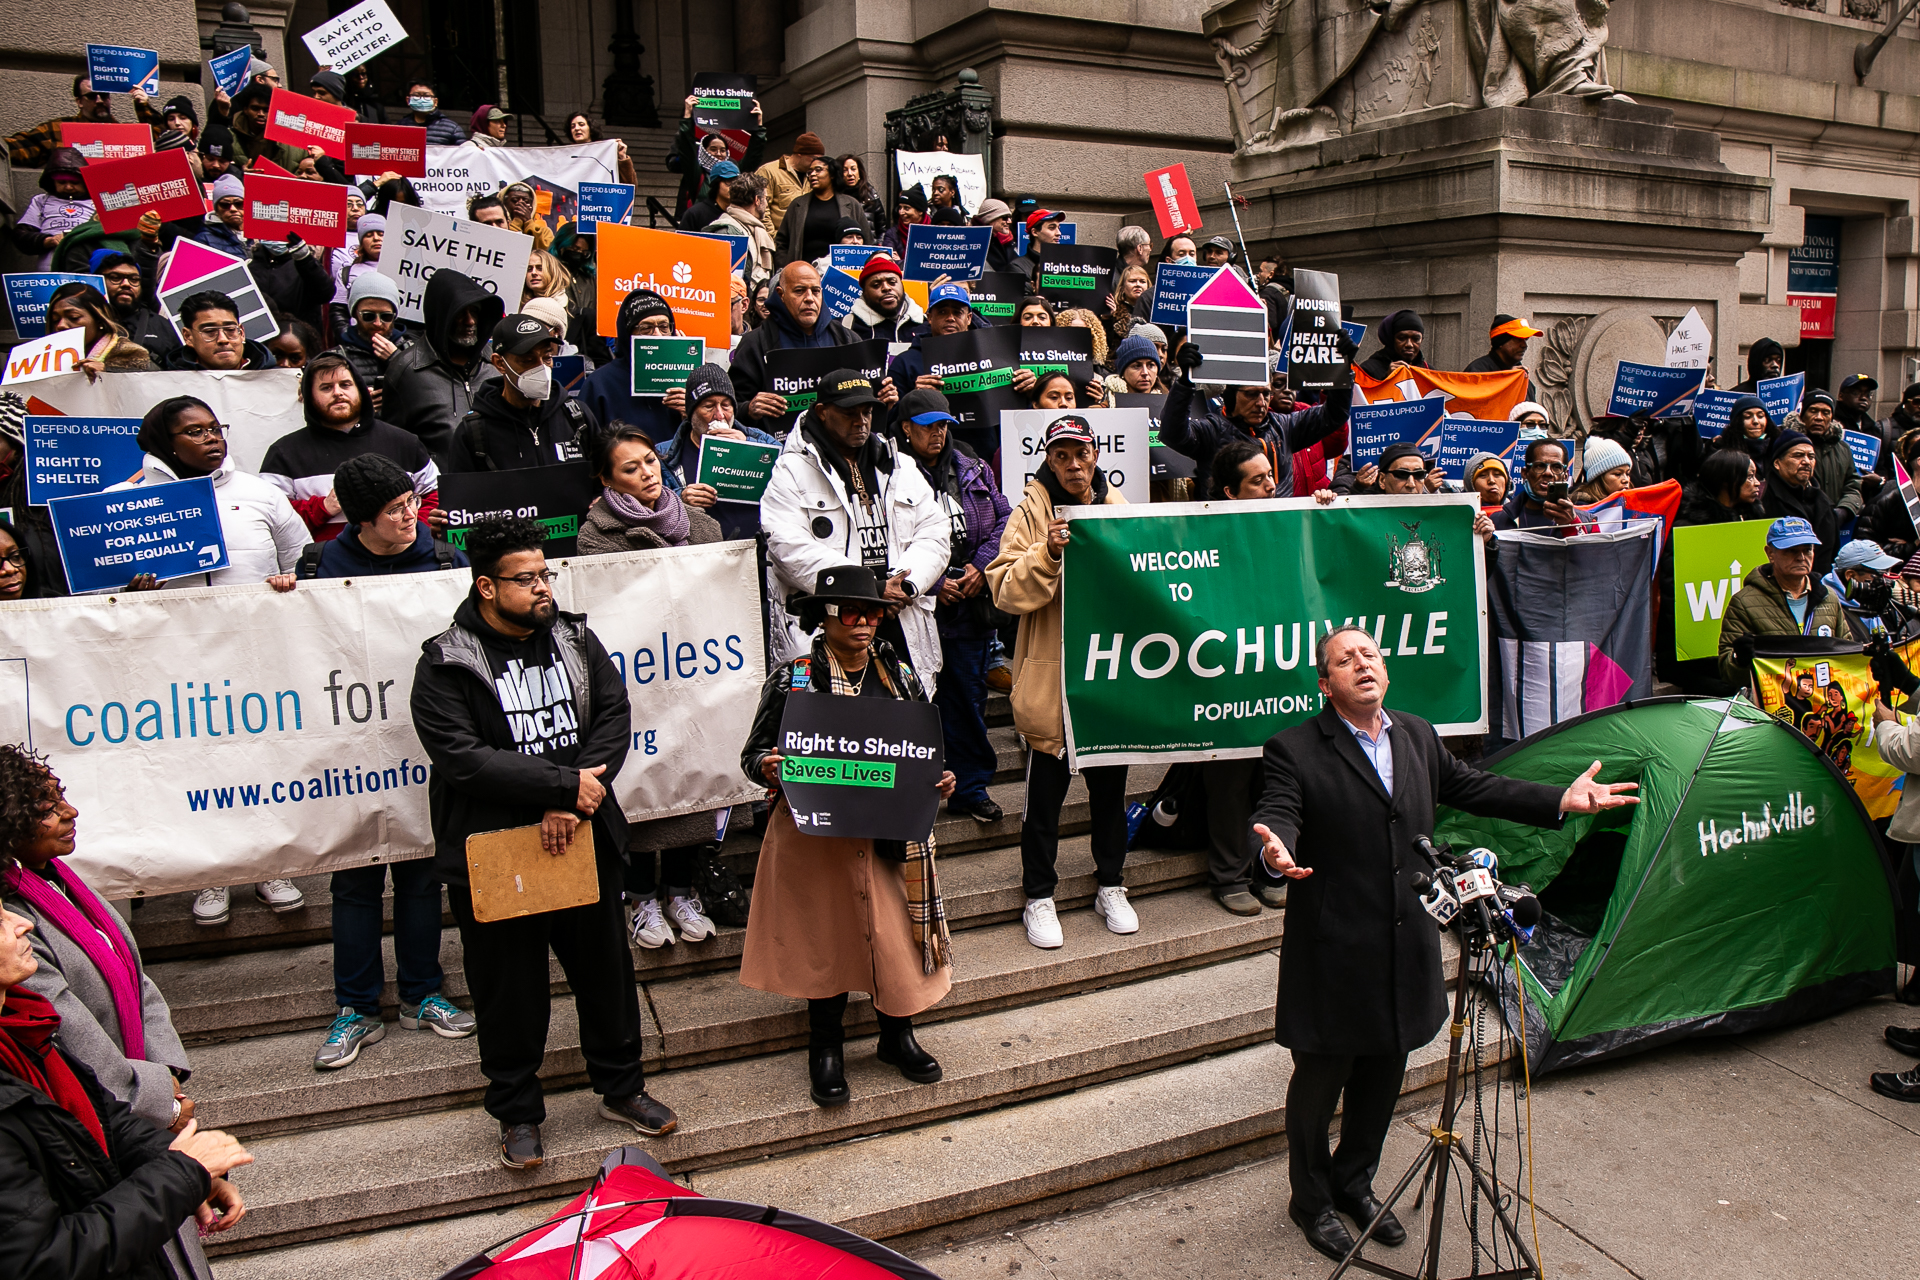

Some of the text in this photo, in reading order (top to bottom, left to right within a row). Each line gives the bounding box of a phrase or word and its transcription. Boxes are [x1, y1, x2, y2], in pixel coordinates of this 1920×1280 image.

[319, 9, 376, 46] SAVE THE
[327, 22, 383, 57] RIGHT TO
[91, 48, 117, 57] DEFEND
[335, 33, 391, 70] SHELTER!
[93, 65, 117, 73] RIGHT
[94, 74, 129, 82] SHELTER
[694, 88, 754, 98] Right to Shelter
[719, 99, 740, 108] Lives
[305, 119, 346, 137] HENRY STREET
[304, 126, 346, 144] SETTLEMENT
[104, 144, 124, 152] HENRY
[381, 146, 419, 156] HENRY STREET
[381, 153, 419, 162] SETTLEMENT
[447, 169, 470, 178] FOR
[138, 178, 187, 197] HENRY STREET
[466, 182, 491, 192] AND
[581, 186, 605, 194] DEFEND
[140, 186, 191, 205] SETTLEMENT
[581, 194, 592, 202] THE
[290, 206, 339, 220] HENRY STREET
[581, 204, 613, 215] RIGHT TO
[290, 215, 339, 228] SETTLEMENT
[581, 215, 612, 223] SHELTER
[932, 243, 952, 251] YORK
[952, 243, 982, 251] SHELTER
[1804, 235, 1834, 247] TIONAL
[402, 229, 506, 269] SAVE THE
[1791, 246, 1834, 260] ARCHIVES
[929, 252, 945, 260] FOR
[398, 259, 437, 282] RIG
[920, 261, 971, 270] NEED EQUALLY
[1044, 261, 1110, 275] Right to Shelter
[1162, 269, 1191, 279] DEFEND
[11, 279, 49, 289] DEFEND
[1043, 276, 1095, 287] Saves Lives
[1161, 279, 1176, 287] THE
[614, 272, 717, 304] safehorizon
[824, 284, 842, 298] NEW
[14, 290, 33, 299] THE
[1159, 291, 1188, 301] RIGHT
[17, 302, 50, 313] RIGHT
[835, 300, 850, 313] FOR
[983, 304, 1014, 314] Adams!
[1296, 298, 1340, 313] HOUSING
[1792, 299, 1822, 309] MUSEUM
[1314, 316, 1325, 327] IS
[1801, 321, 1820, 331] DIAN
[1290, 346, 1345, 364] CARE
[1671, 343, 1704, 355] HAVE THE
[1032, 350, 1088, 363] to Shelter
[644, 362, 696, 371] HOCHULVILLE
[930, 358, 993, 377] Shame on
[1622, 365, 1687, 380] DEFEND UPHOLD
[978, 368, 1014, 387] Adams!
[1620, 375, 1634, 384] THE
[774, 377, 814, 394] Right
[1617, 385, 1658, 398] RIGHT TO
[1615, 395, 1654, 409] SHELTER
[1694, 402, 1709, 411] NEW
[1355, 405, 1426, 420] DEFEND UPHOLD
[1706, 412, 1720, 421] FOR
[33, 424, 140, 436] DEFEND & UPHOLD
[1355, 421, 1372, 430] THE
[1444, 423, 1504, 434] DEFEND UPHOLD
[1698, 419, 1716, 429] NEED
[34, 438, 59, 449] THE
[1357, 432, 1400, 445] RIGHT TO
[1444, 433, 1458, 442] THE
[709, 446, 730, 454] WELCOME
[1442, 445, 1479, 455] RIGHT TO
[36, 457, 102, 468] RIGHT TO
[711, 465, 765, 479] HOCHULVILLE
[36, 473, 100, 484] SHELTER
[106, 496, 165, 514] NY SANE:
[516, 505, 538, 519] on
[69, 507, 203, 538] NEW YORK SHELTER
[105, 527, 178, 550] FOR ALL IN
[94, 540, 196, 567] NEED EQUALLY
[1129, 548, 1220, 572] WELCOME
[1168, 581, 1193, 603] TO
[610, 631, 745, 685] eless
[65, 668, 395, 747] coalition for
[1194, 693, 1313, 722] POPULATION:
[506, 701, 578, 743] VOCAL
[548, 732, 578, 751] YOR
[785, 731, 937, 761] Right to Shelter
[1100, 744, 1121, 752] people
[1128, 743, 1150, 751] shelters
[1150, 743, 1166, 751] each
[1166, 742, 1181, 751] night
[1201, 740, 1214, 748] York
[784, 759, 891, 784] Saves Lives
[186, 758, 430, 812] www.coalitionfo
[1431, 898, 1449, 915] news
[1436, 901, 1459, 921] 12
